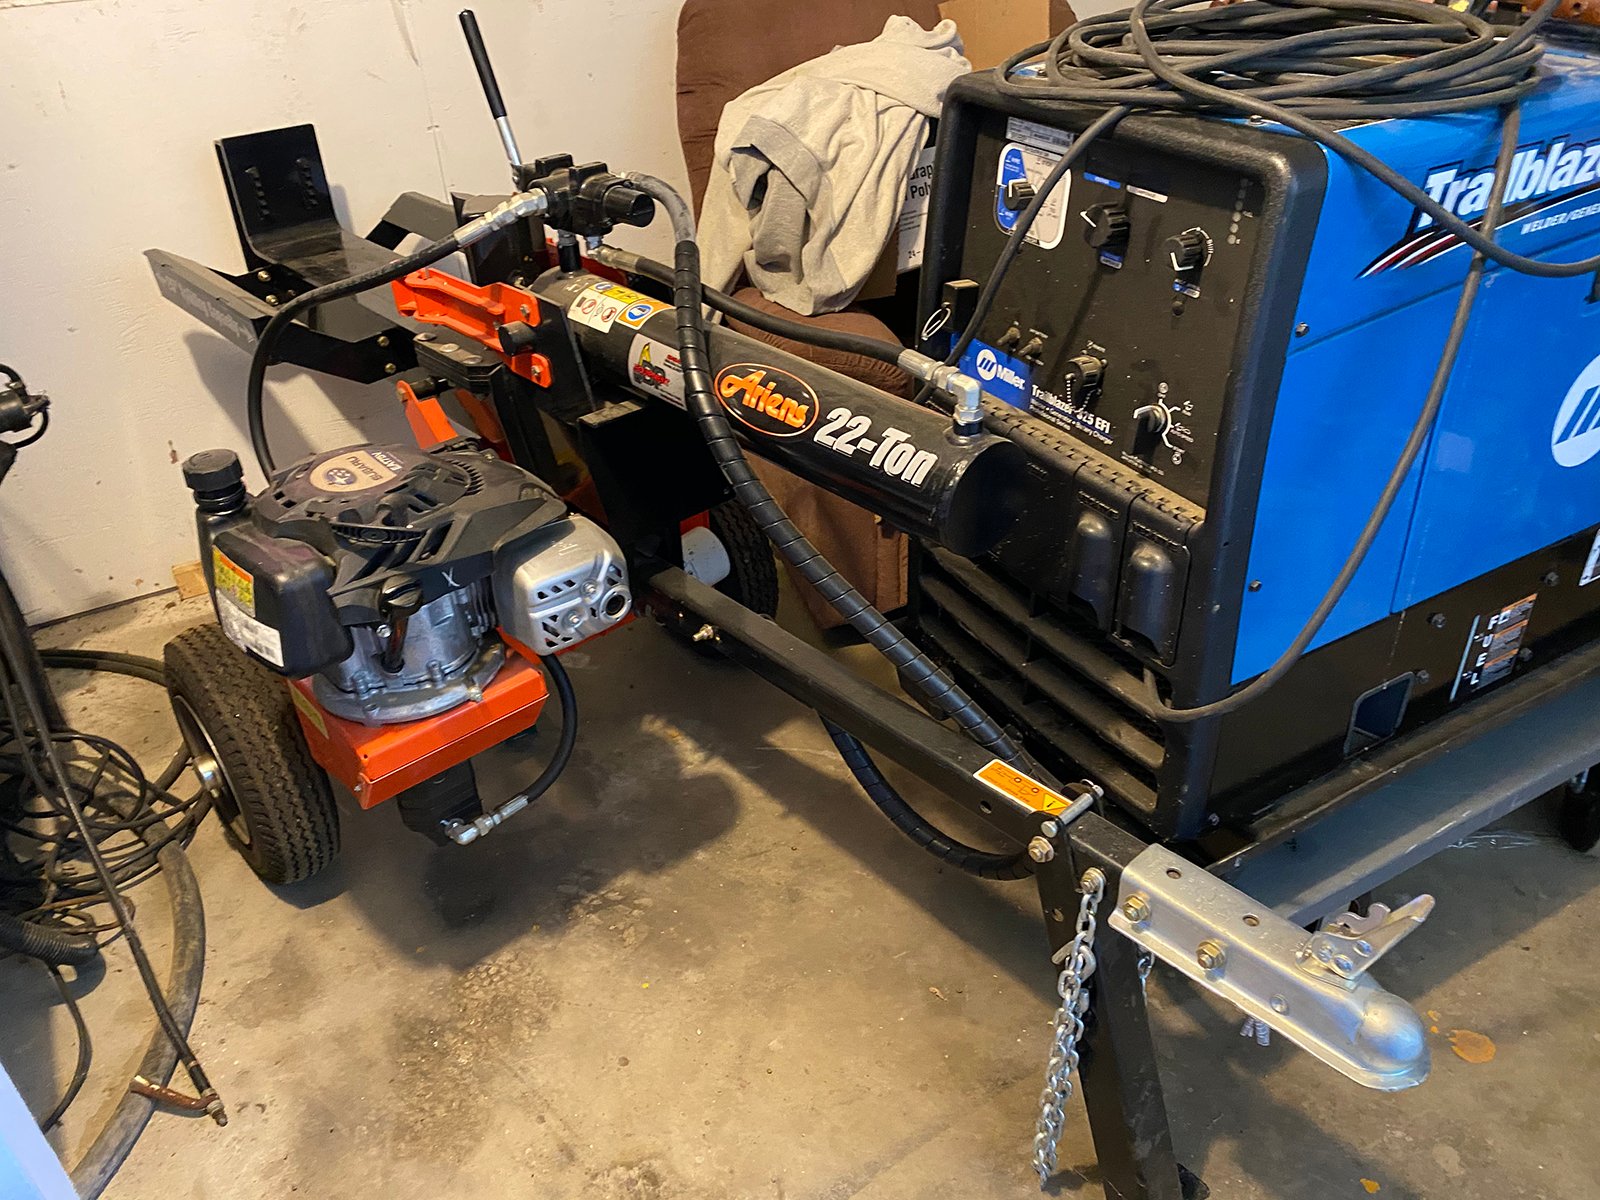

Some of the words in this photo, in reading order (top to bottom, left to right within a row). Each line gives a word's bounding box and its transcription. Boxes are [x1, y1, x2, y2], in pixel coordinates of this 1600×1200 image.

[910, 164, 933, 180] rap
[1417, 141, 1600, 228] Tralblaz
[719, 369, 810, 429] Ariens
[345, 456, 384, 481] SUBARU
[813, 407, 939, 488] 22-Ton
